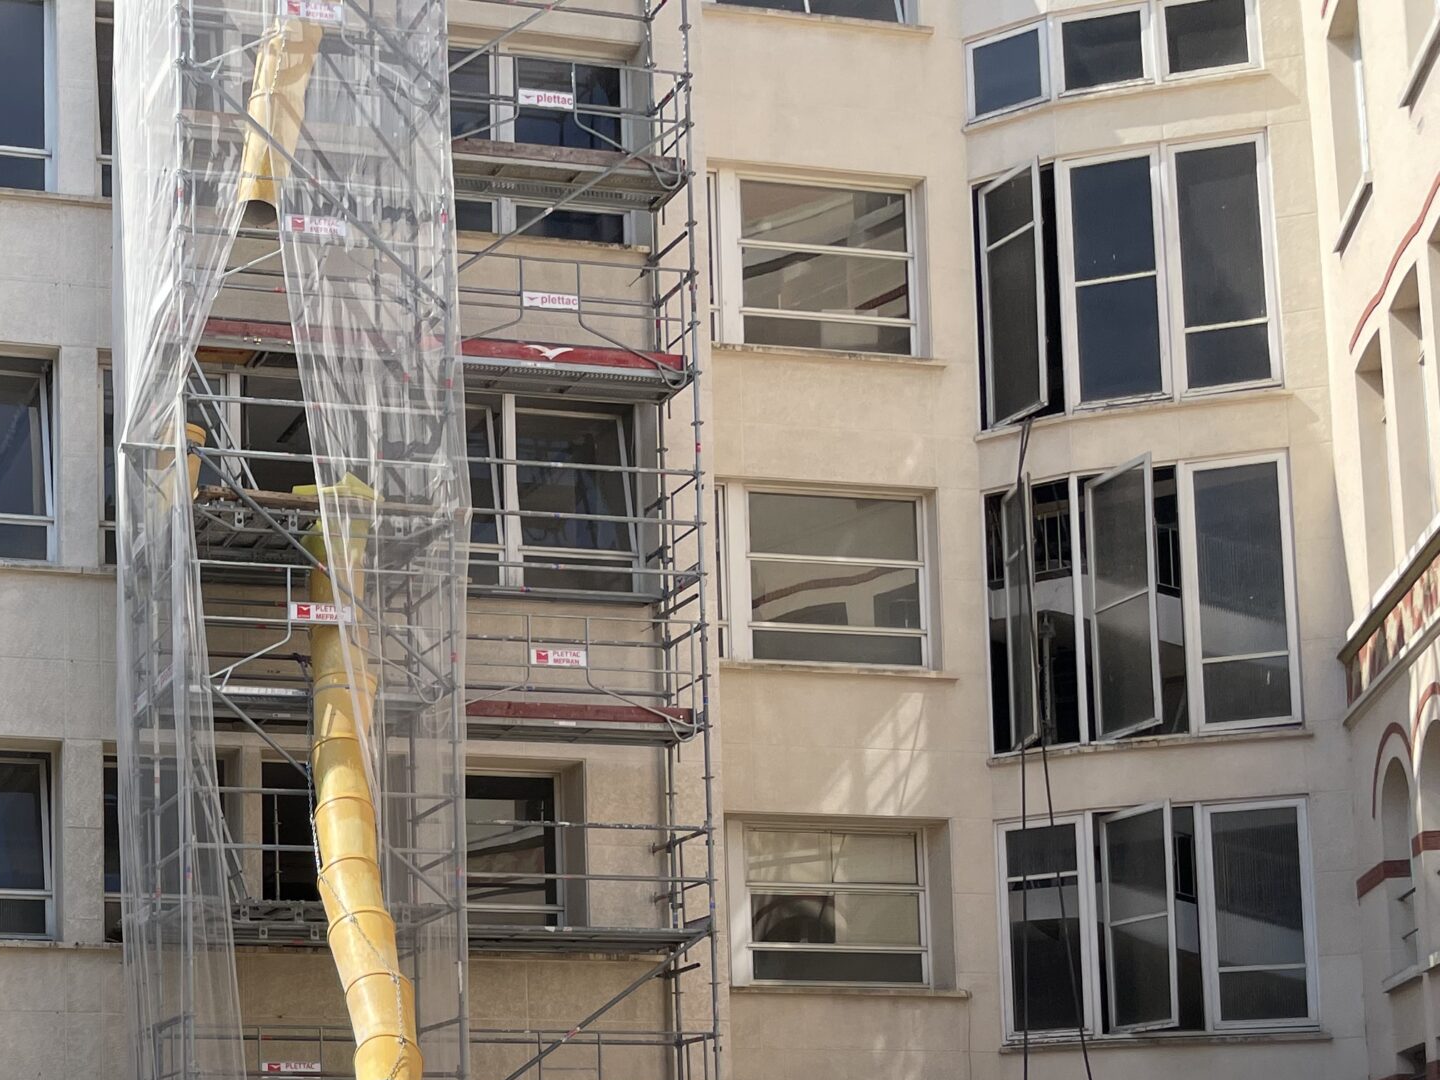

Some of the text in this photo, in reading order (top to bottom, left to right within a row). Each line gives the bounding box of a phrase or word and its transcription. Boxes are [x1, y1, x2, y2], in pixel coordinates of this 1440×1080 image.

[536, 93, 573, 105] plettac
[541, 295, 578, 306] plettac
[552, 650, 581, 658] PLETTAC
